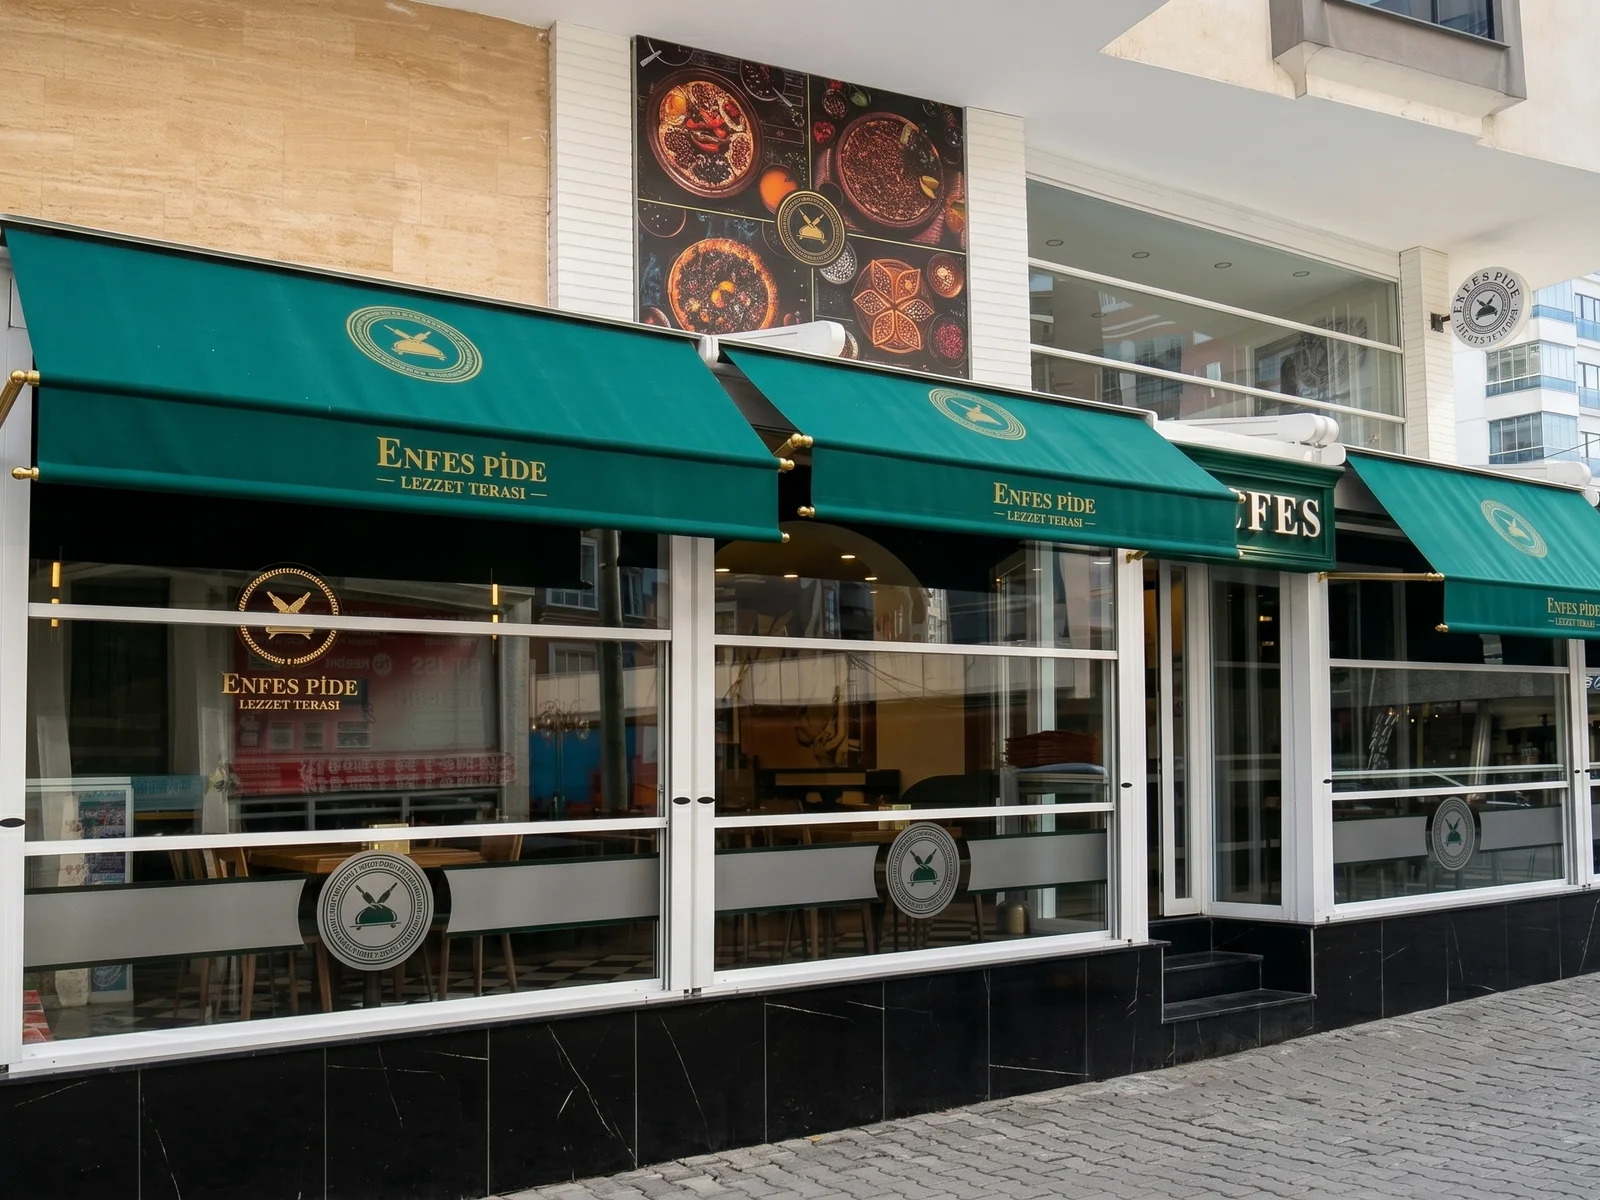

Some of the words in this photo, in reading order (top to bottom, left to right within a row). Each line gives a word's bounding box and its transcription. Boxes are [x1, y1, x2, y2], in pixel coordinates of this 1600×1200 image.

[376, 436, 475, 475] ENFES
[483, 451, 547, 483] PİDE
[401, 476, 465, 494] LEZZET
[468, 482, 526, 500] TERASI
[993, 481, 1052, 510] ENFES
[1057, 491, 1096, 514] PİDE
[1007, 510, 1046, 525] LEZZET
[1048, 515, 1083, 528] TERASI
[1229, 487, 1321, 538] FES
[1547, 597, 1577, 615] ENFES
[221, 671, 299, 695] ENFES
[305, 675, 359, 696] PİDE
[239, 699, 291, 711] LEZZET
[293, 700, 341, 711] TERASI
